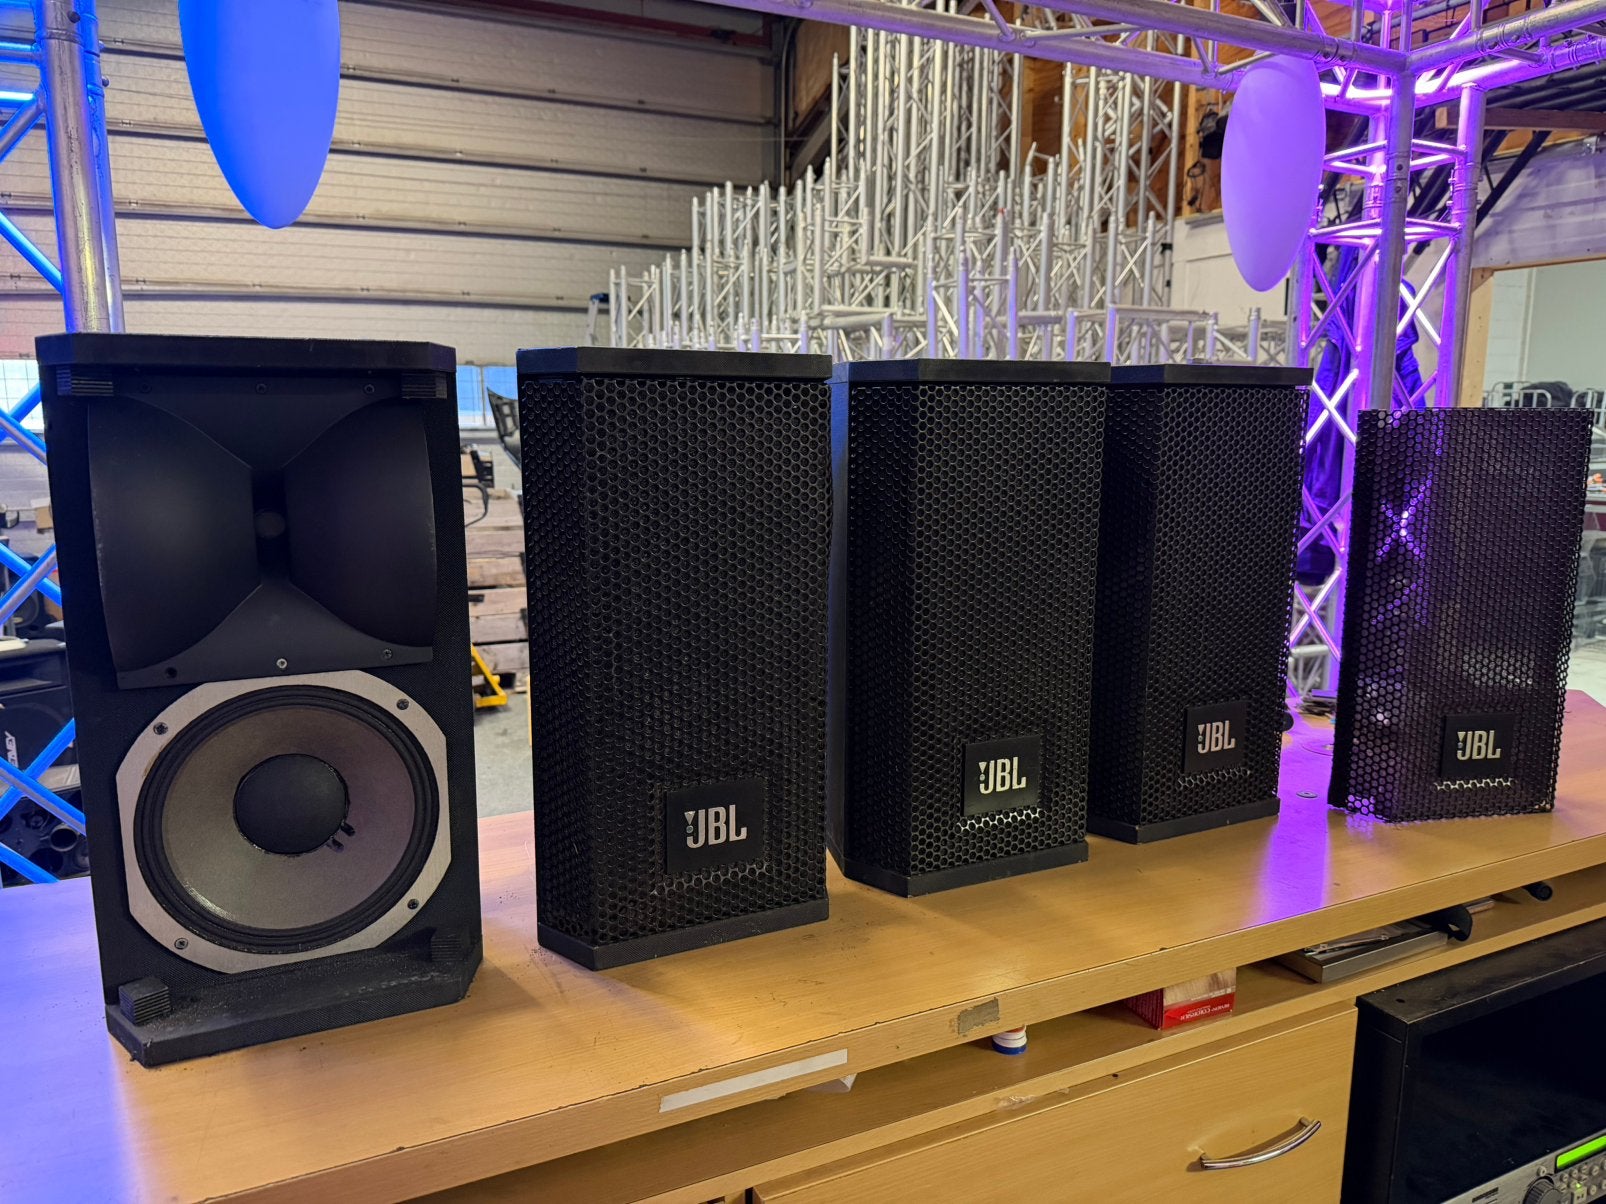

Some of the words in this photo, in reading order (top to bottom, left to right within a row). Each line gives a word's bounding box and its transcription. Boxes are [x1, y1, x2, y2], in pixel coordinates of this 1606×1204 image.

[4, 730, 19, 769] EAVEY
[1197, 720, 1236, 754] JBL
[1456, 729, 1502, 761] JBL
[978, 756, 1027, 795] JBL
[684, 804, 748, 849] JBL
